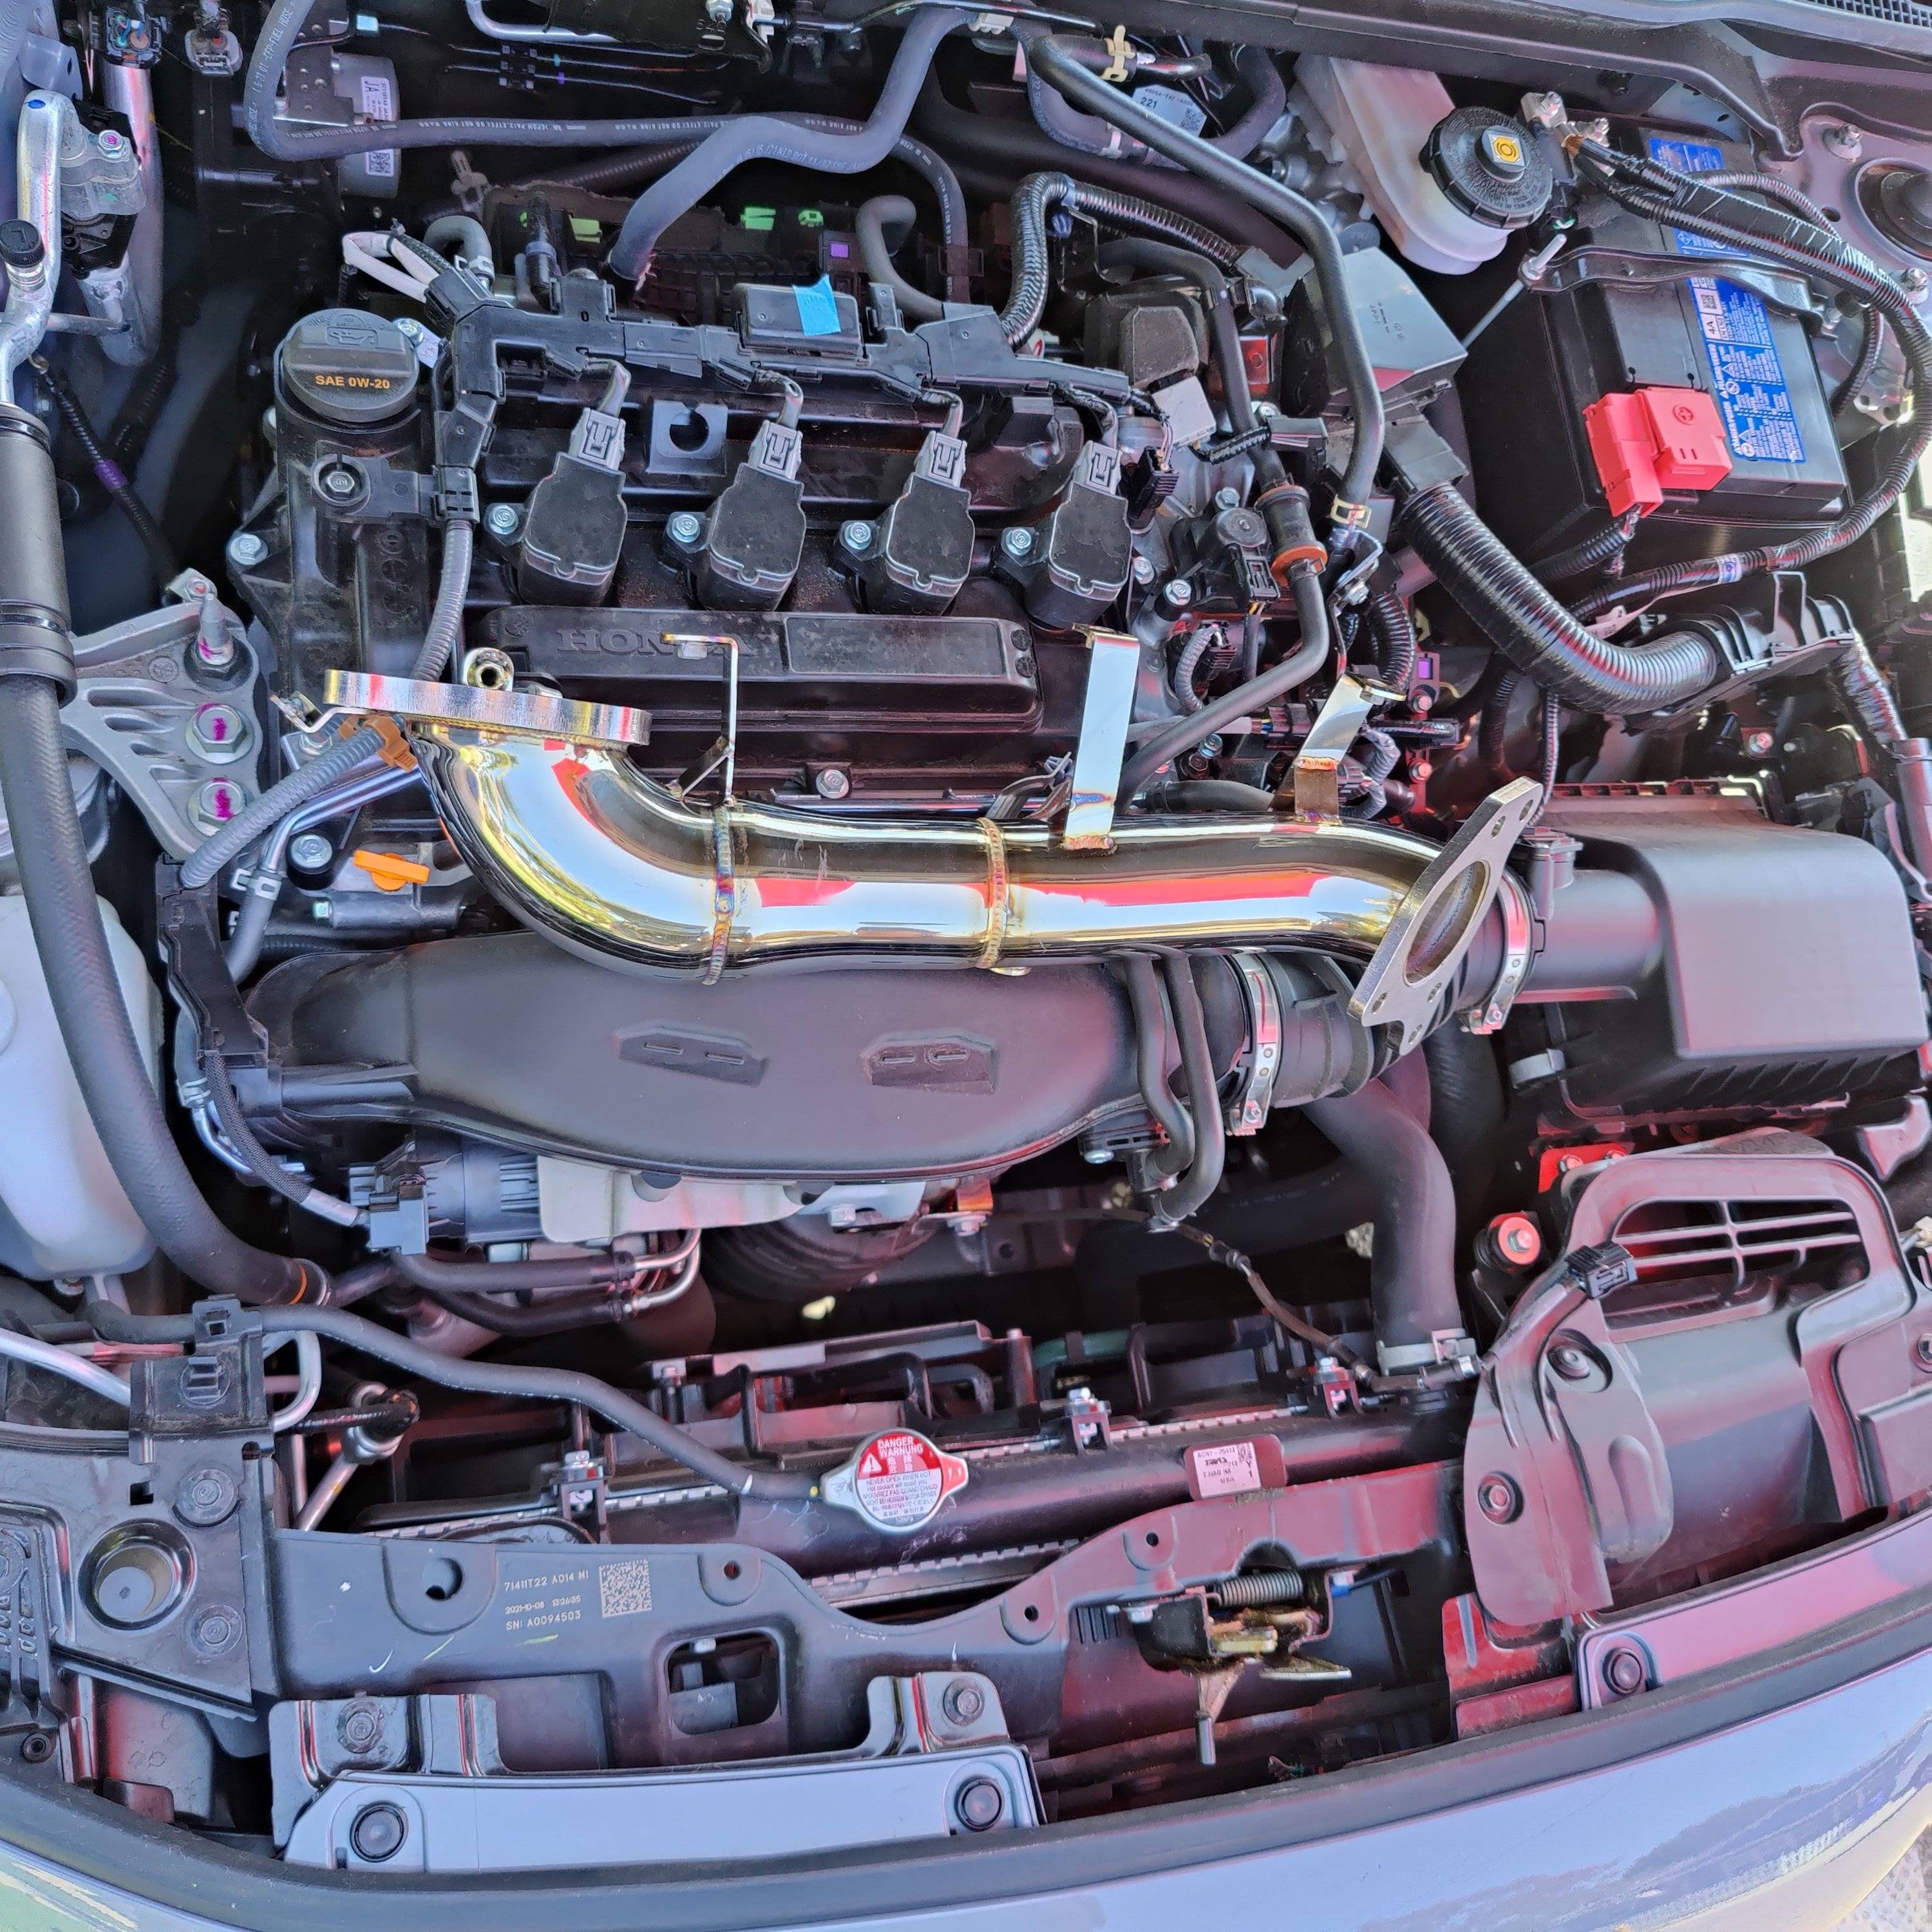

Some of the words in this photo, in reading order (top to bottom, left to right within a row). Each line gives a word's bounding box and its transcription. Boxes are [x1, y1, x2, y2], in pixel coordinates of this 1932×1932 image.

[1141, 97, 1157, 108] 221
[1706, 321, 1716, 334] 4A
[315, 375, 345, 386] SAE
[348, 377, 390, 389] 0W-20
[557, 629, 757, 656] HONA
[877, 1436, 914, 1448] DANGER
[879, 1444, 923, 1459] WARNUNG
[866, 1476, 886, 1484] NEVER
[902, 1473, 918, 1481] WHEN
[504, 1577, 547, 1592] 71411T22
[552, 1572, 574, 1585] A014
[505, 1600, 545, 1615] 2021-10-08
[527, 1610, 582, 1629] A0094503
